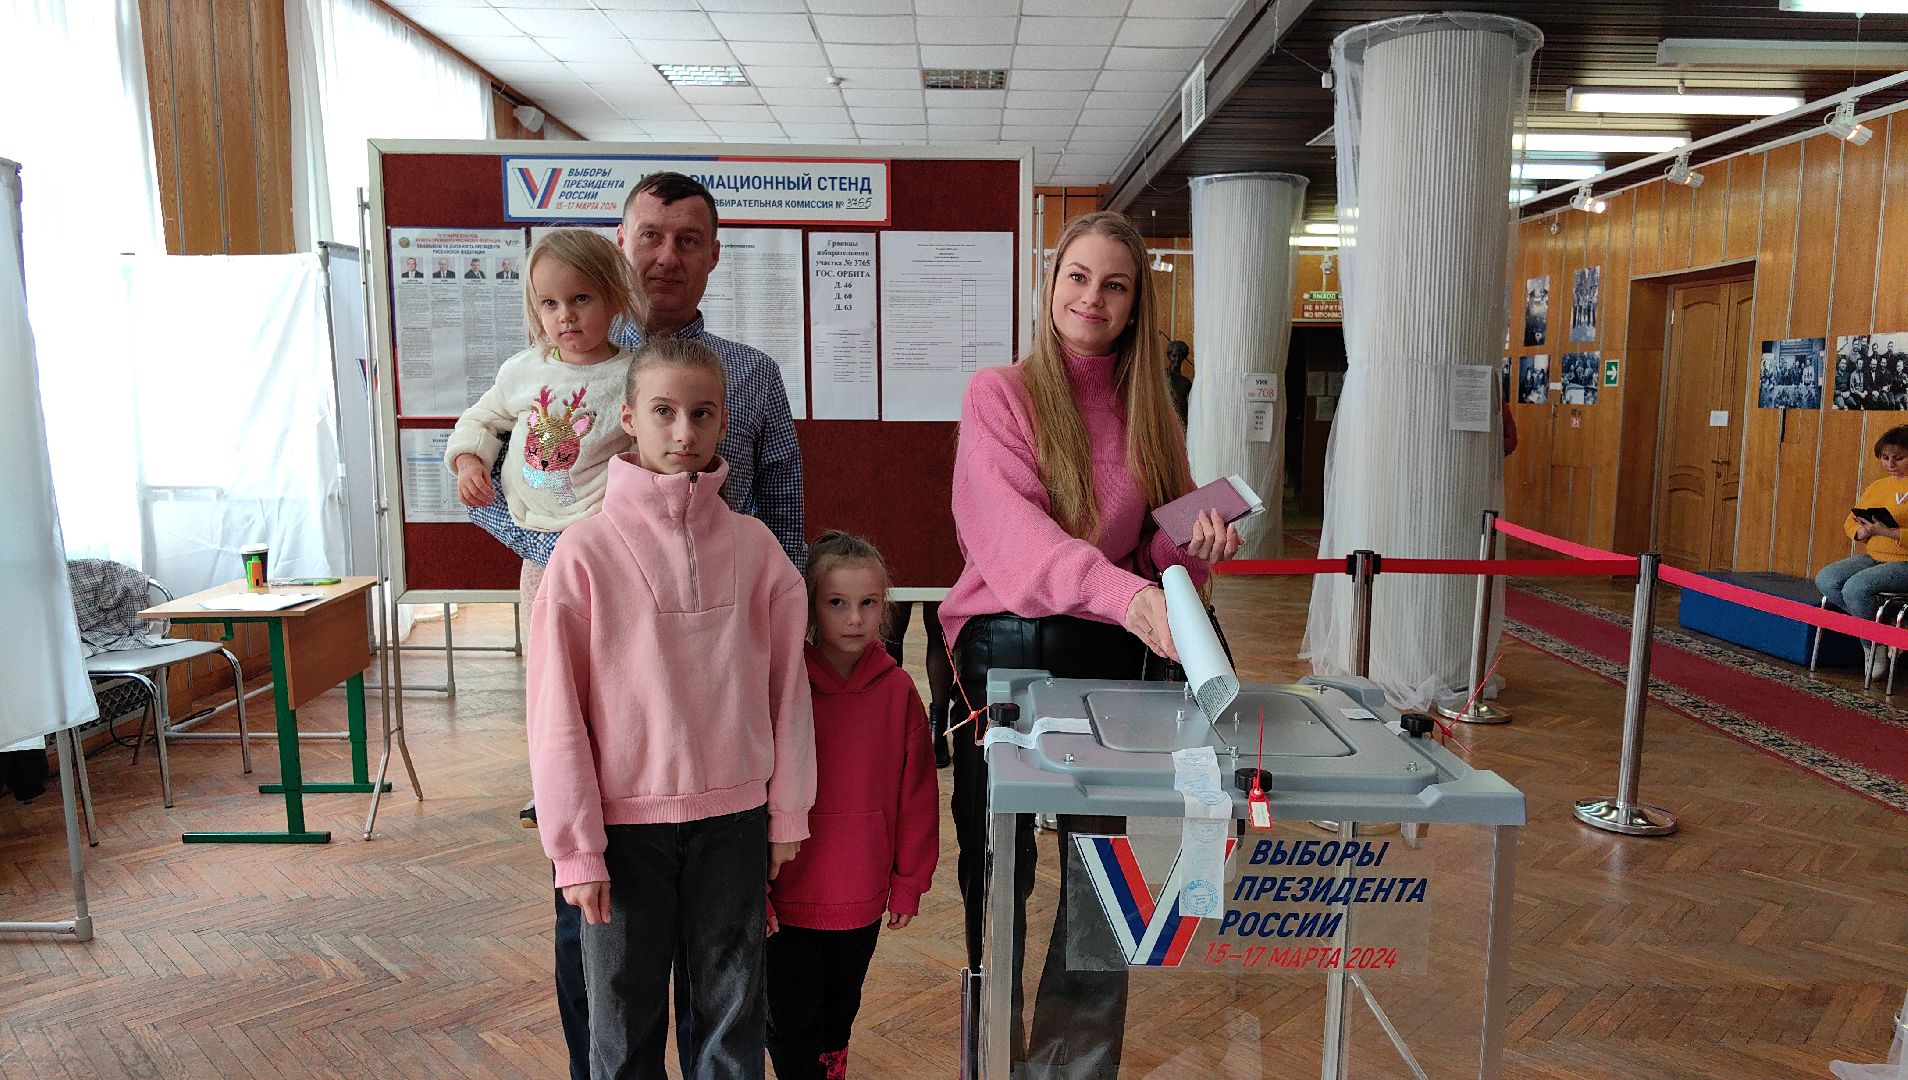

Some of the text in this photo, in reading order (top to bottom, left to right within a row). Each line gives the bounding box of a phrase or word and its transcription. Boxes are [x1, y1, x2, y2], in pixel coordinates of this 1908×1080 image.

[568, 168, 612, 177] ВЫБОРЫ
[563, 180, 625, 189] ПРЕЗИДЕНТА
[641, 173, 872, 194] РМАЦИОННЫЙ СТЕНД
[559, 191, 599, 200] РОССИИ
[575, 202, 599, 210] МАРТА
[714, 199, 784, 208] ЗБИРАТЕЛЬНАЯ
[785, 199, 833, 209] КОМИССИЯ
[836, 200, 845, 208] №
[828, 240, 859, 248] Границы
[837, 270, 871, 278] ОРБИТА
[1257, 388, 1274, 399] 708
[1249, 839, 1390, 867] ВЫБОРЫ
[1233, 875, 1428, 906] ПРЕЗИДЕНТА
[1218, 909, 1344, 938] РОССИИ
[1203, 941, 1398, 970] 15–17 МАРТА 2024
